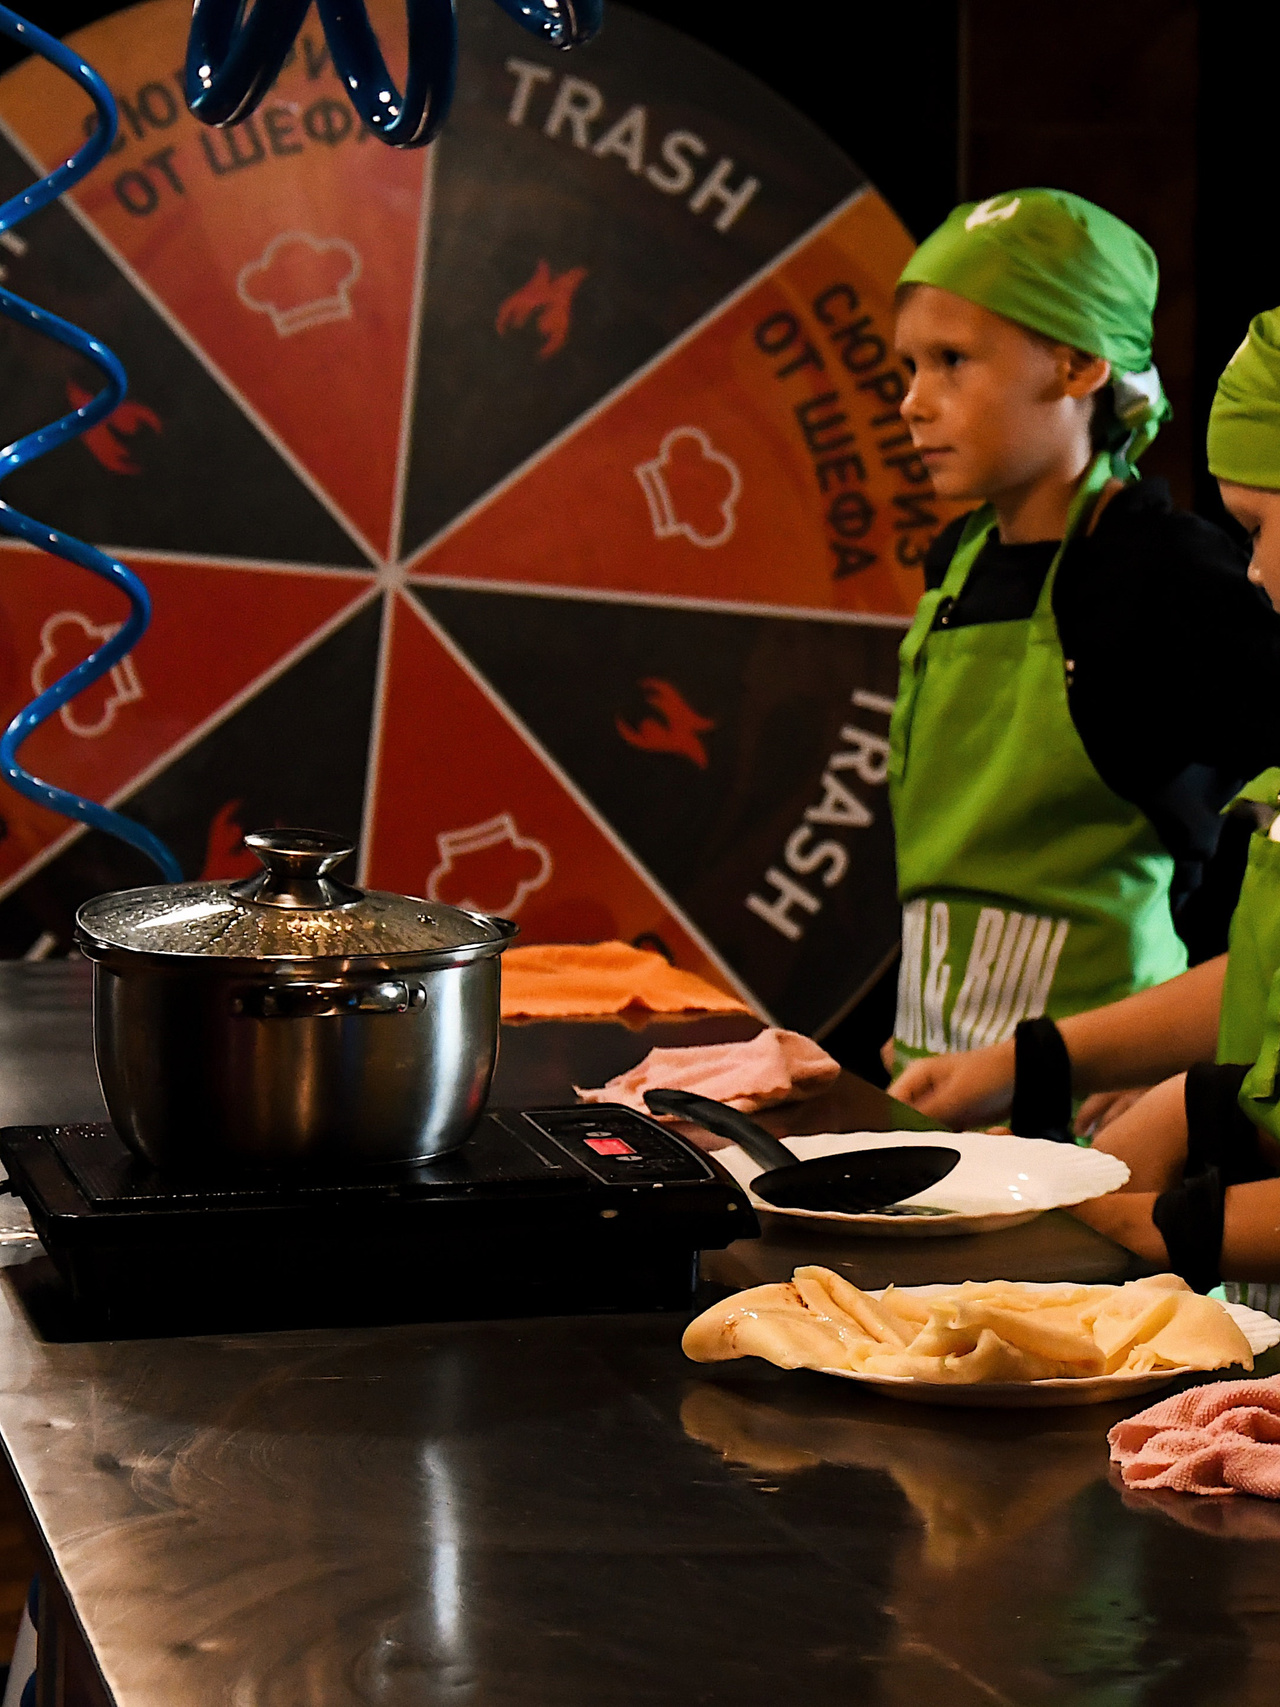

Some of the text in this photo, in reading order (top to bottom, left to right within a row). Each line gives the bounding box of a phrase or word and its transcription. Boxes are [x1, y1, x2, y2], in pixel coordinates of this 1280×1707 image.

[113, 98, 372, 216] ОТ ШЕФ
[505, 56, 763, 235] TRASH
[754, 310, 880, 582] ОТ ШЕФА
